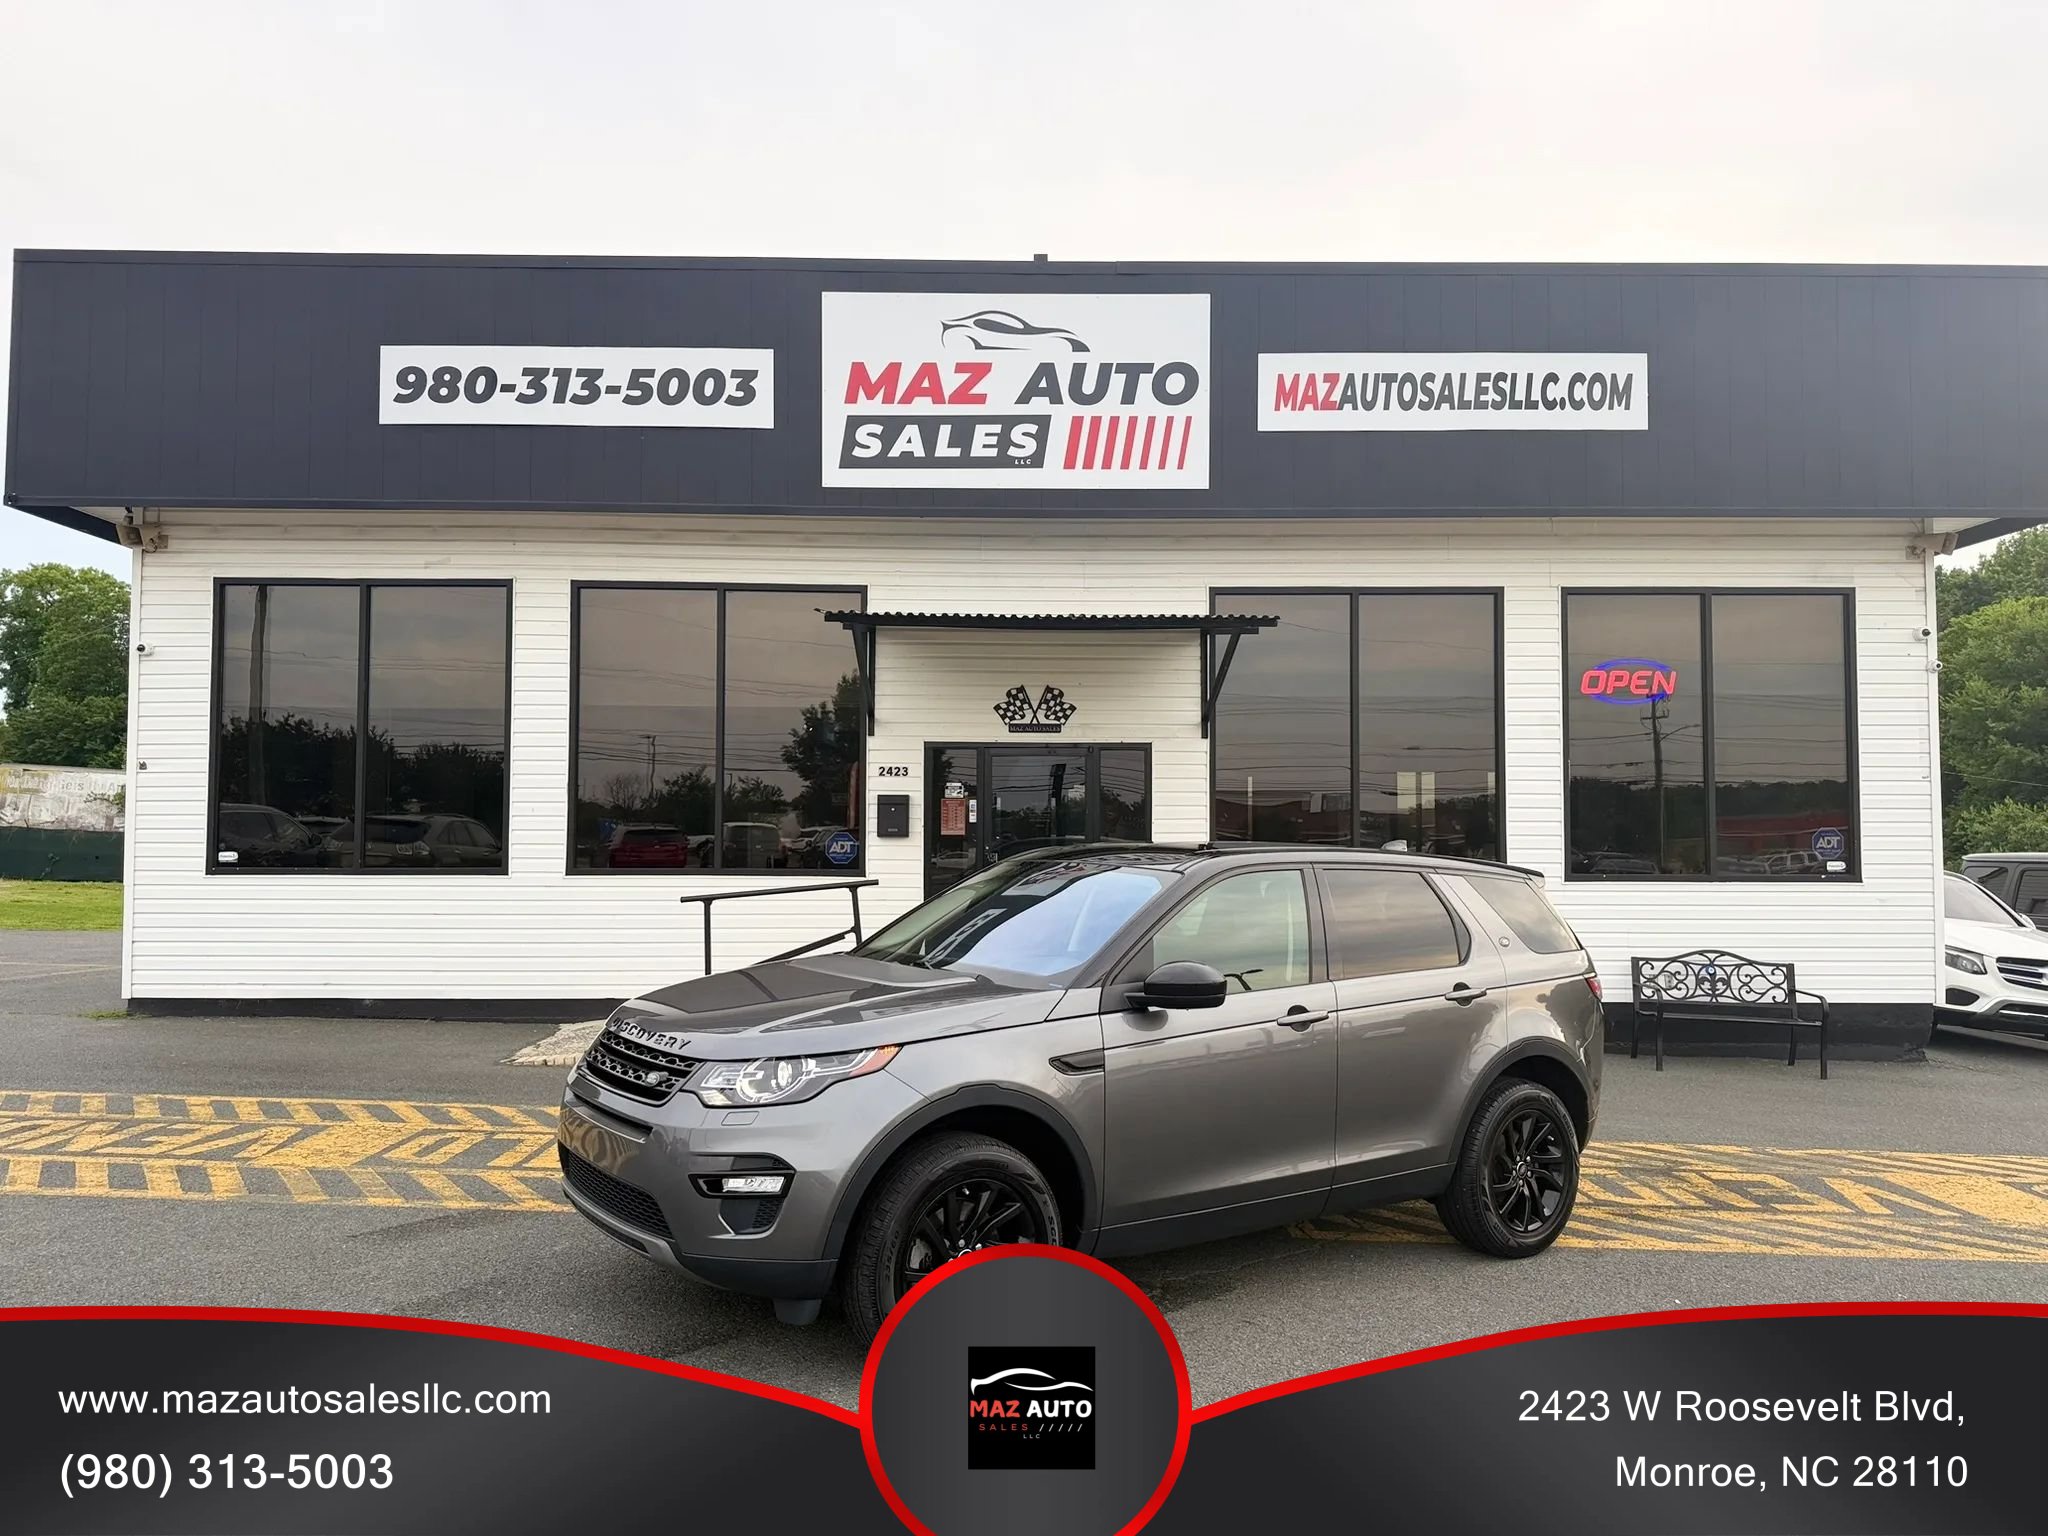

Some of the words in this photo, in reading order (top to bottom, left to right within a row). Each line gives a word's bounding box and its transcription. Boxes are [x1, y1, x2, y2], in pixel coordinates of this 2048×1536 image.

[392, 365, 759, 407] 980-313-5003
[845, 361, 993, 406] MAZ
[1013, 361, 1200, 406] AUTO
[1273, 371, 1634, 412] MAZAUTOSALESLLC.COM
[852, 423, 1039, 458] SALES
[1580, 669, 1677, 695] OPEN
[878, 766, 909, 777] 2423
[828, 841, 854, 854] ADT
[1815, 836, 1841, 849] ADT
[612, 1017, 692, 1050] DISCOVERY
